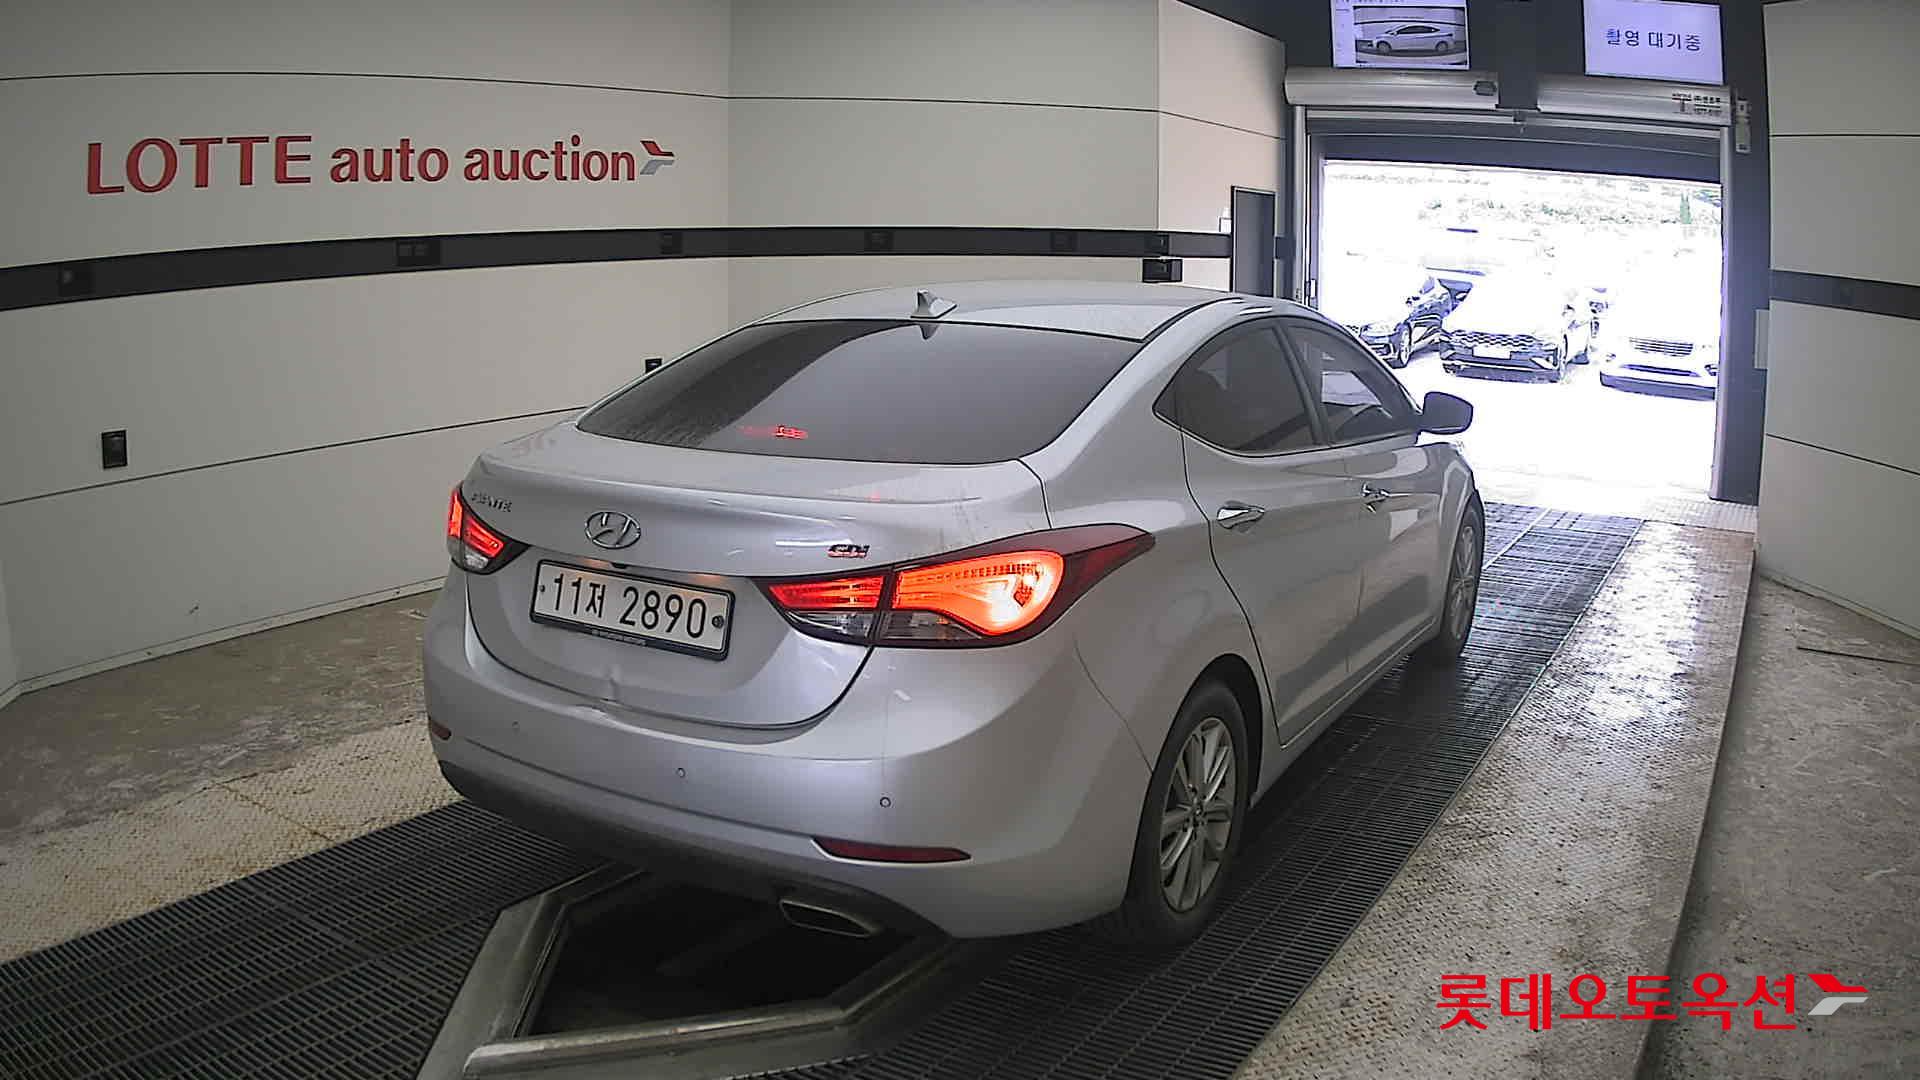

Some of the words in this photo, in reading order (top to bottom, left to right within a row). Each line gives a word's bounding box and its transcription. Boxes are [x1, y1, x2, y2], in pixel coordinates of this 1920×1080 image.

[1647, 31, 1702, 52] 대기중
[87, 135, 312, 194] LOTTE
[329, 138, 449, 182] auto
[463, 134, 636, 181] auction
[553, 573, 607, 618] 11저
[618, 586, 708, 639] 2890
